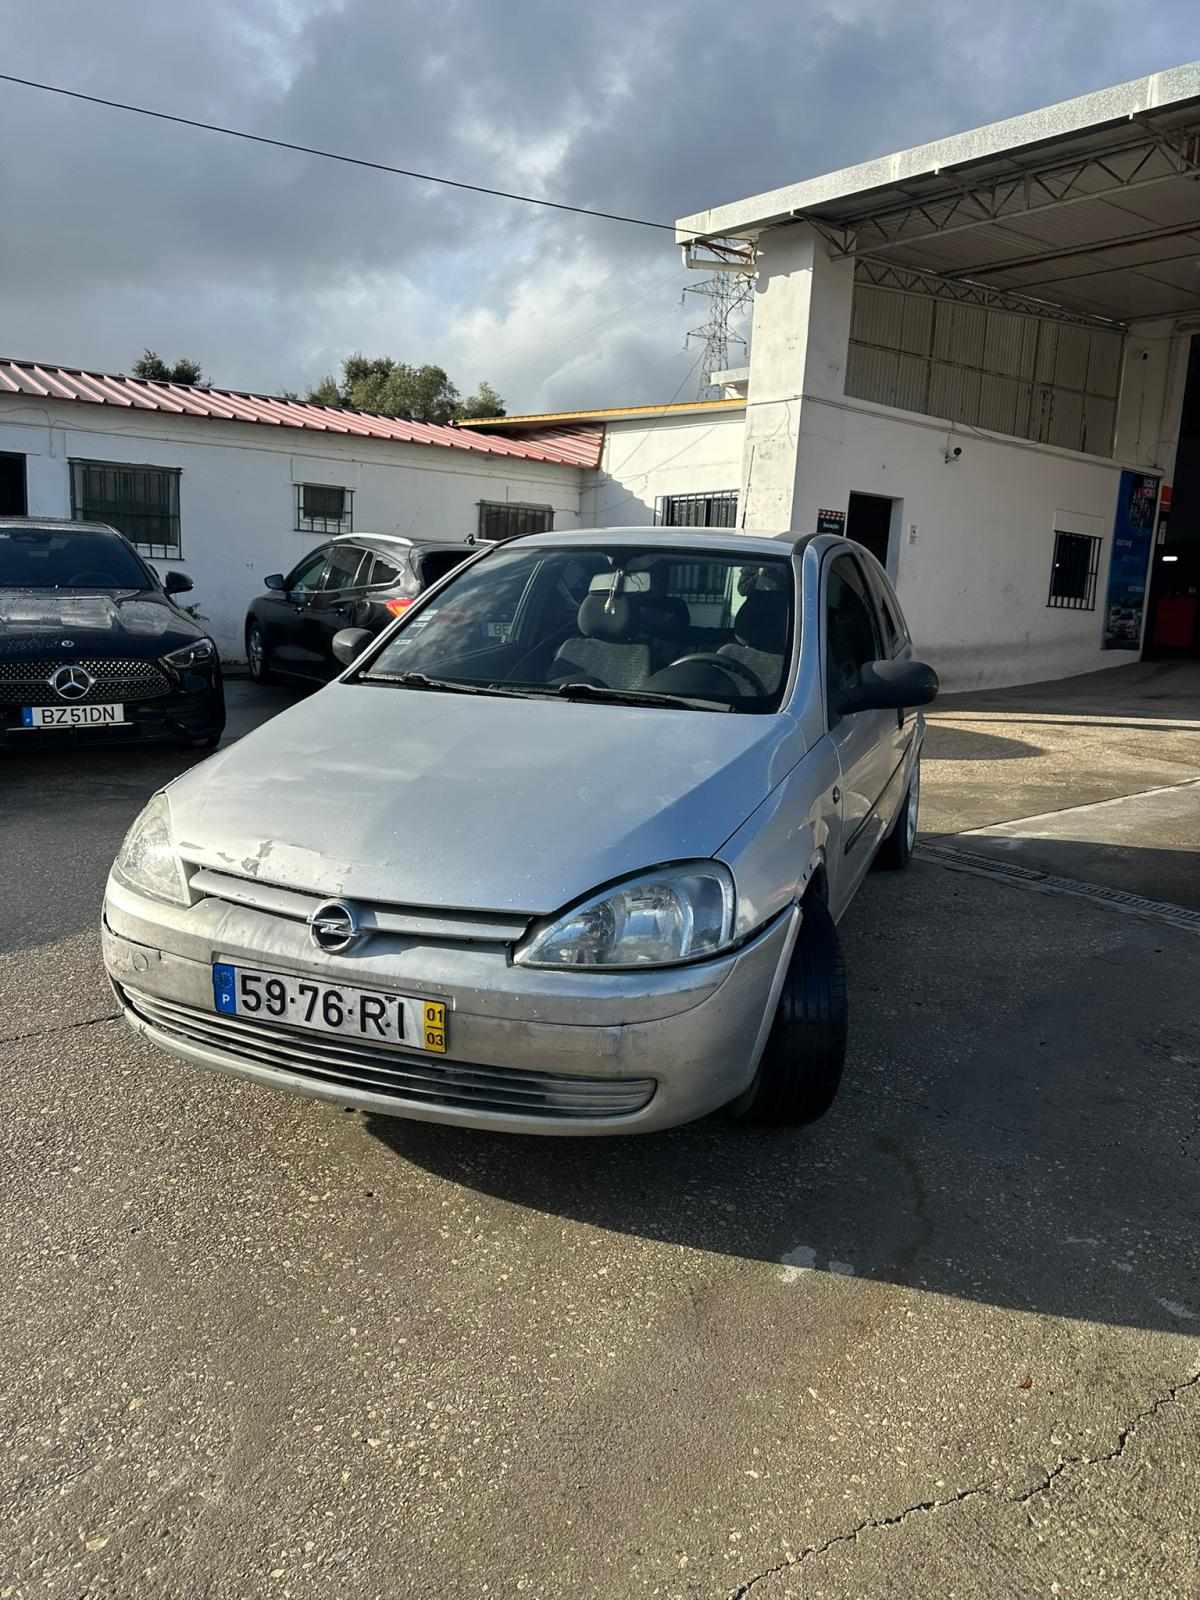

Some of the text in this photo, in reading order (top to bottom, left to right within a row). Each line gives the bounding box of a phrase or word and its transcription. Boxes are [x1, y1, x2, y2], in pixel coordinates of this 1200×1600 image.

[222, 993, 230, 1004] P
[426, 1007, 443, 1023] 01
[426, 1032, 444, 1046] 03
